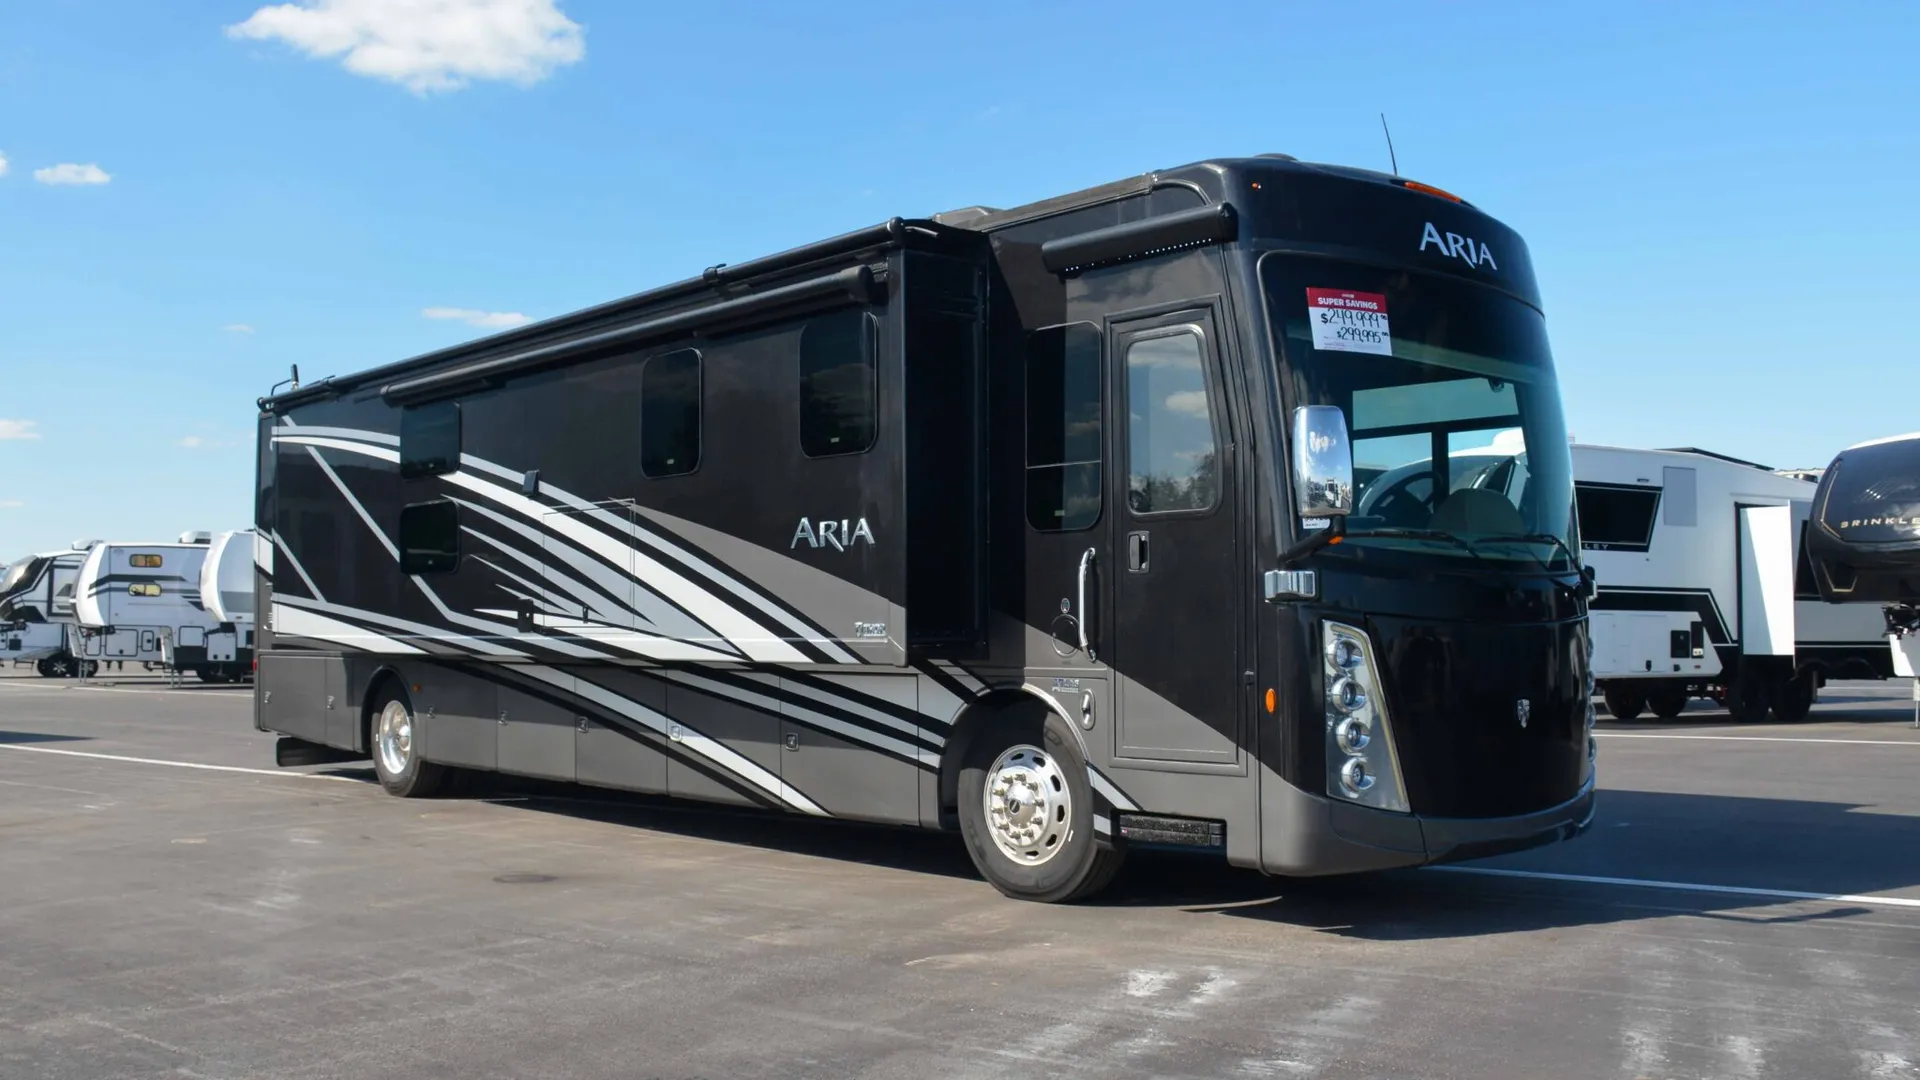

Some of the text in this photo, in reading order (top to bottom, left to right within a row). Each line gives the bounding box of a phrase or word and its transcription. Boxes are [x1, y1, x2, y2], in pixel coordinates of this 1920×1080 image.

[1419, 221, 1498, 271] ARIA
[1317, 297, 1378, 310] SUPER SAVINGS
[790, 516, 876, 553] ARIA
